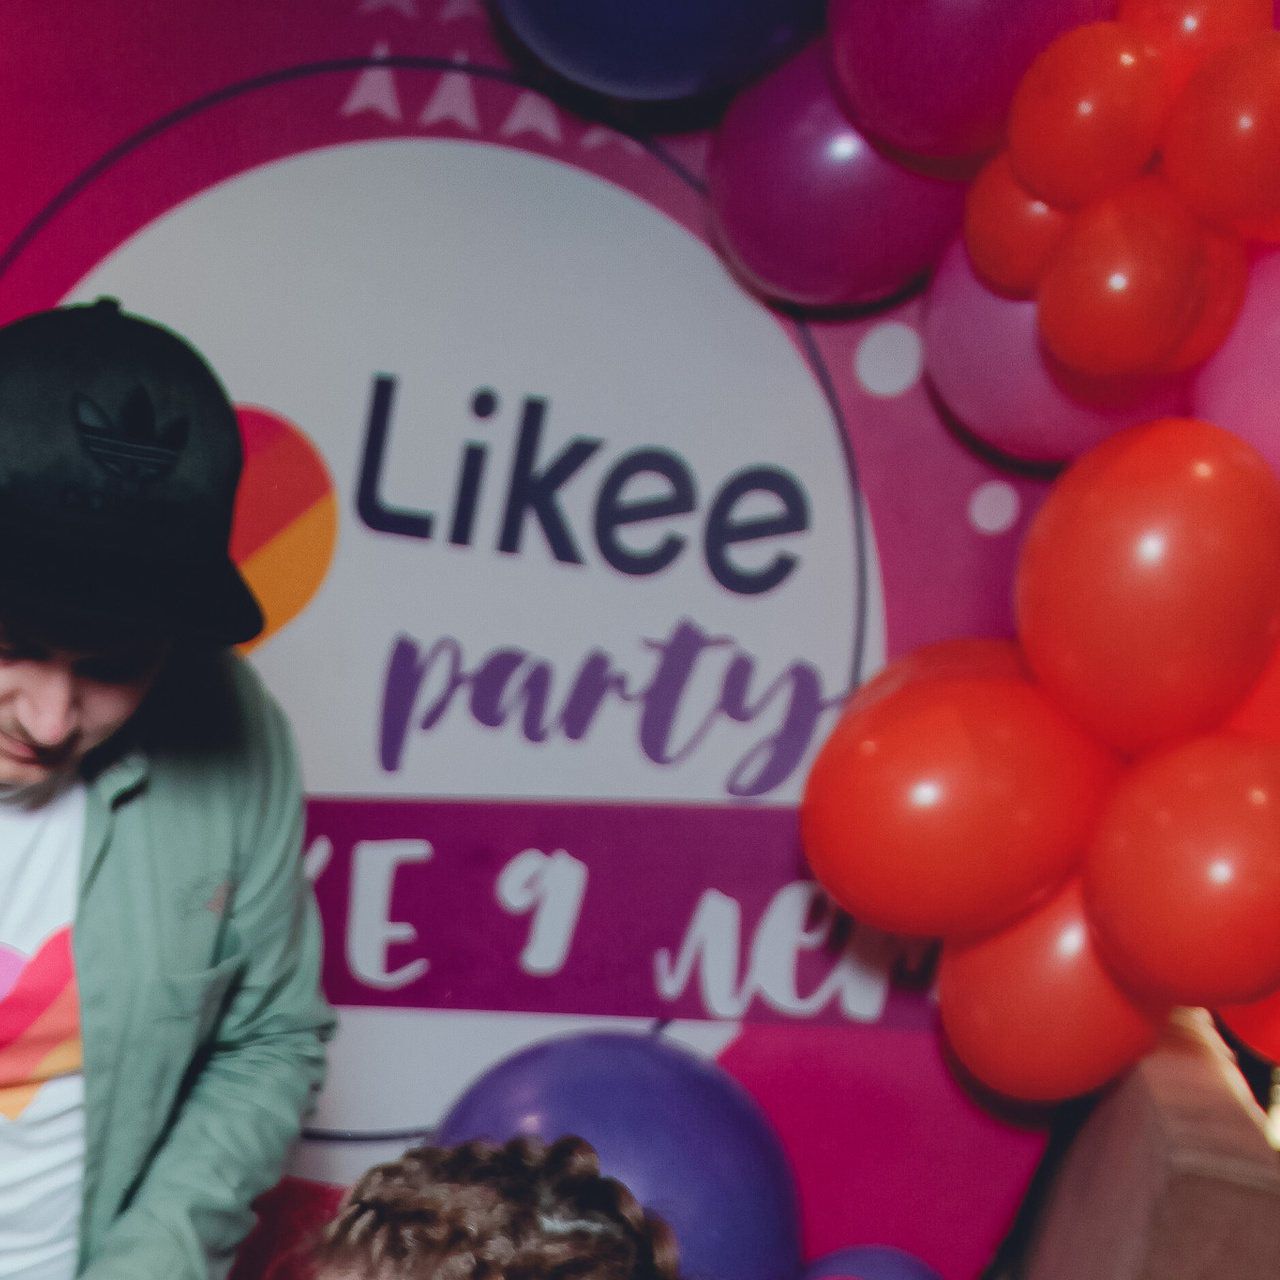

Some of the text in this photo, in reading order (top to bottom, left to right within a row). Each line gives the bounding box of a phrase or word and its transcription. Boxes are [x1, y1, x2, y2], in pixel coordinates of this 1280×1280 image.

[354, 372, 811, 595] Likee
[377, 617, 853, 798] party
[495, 847, 588, 976] 9
